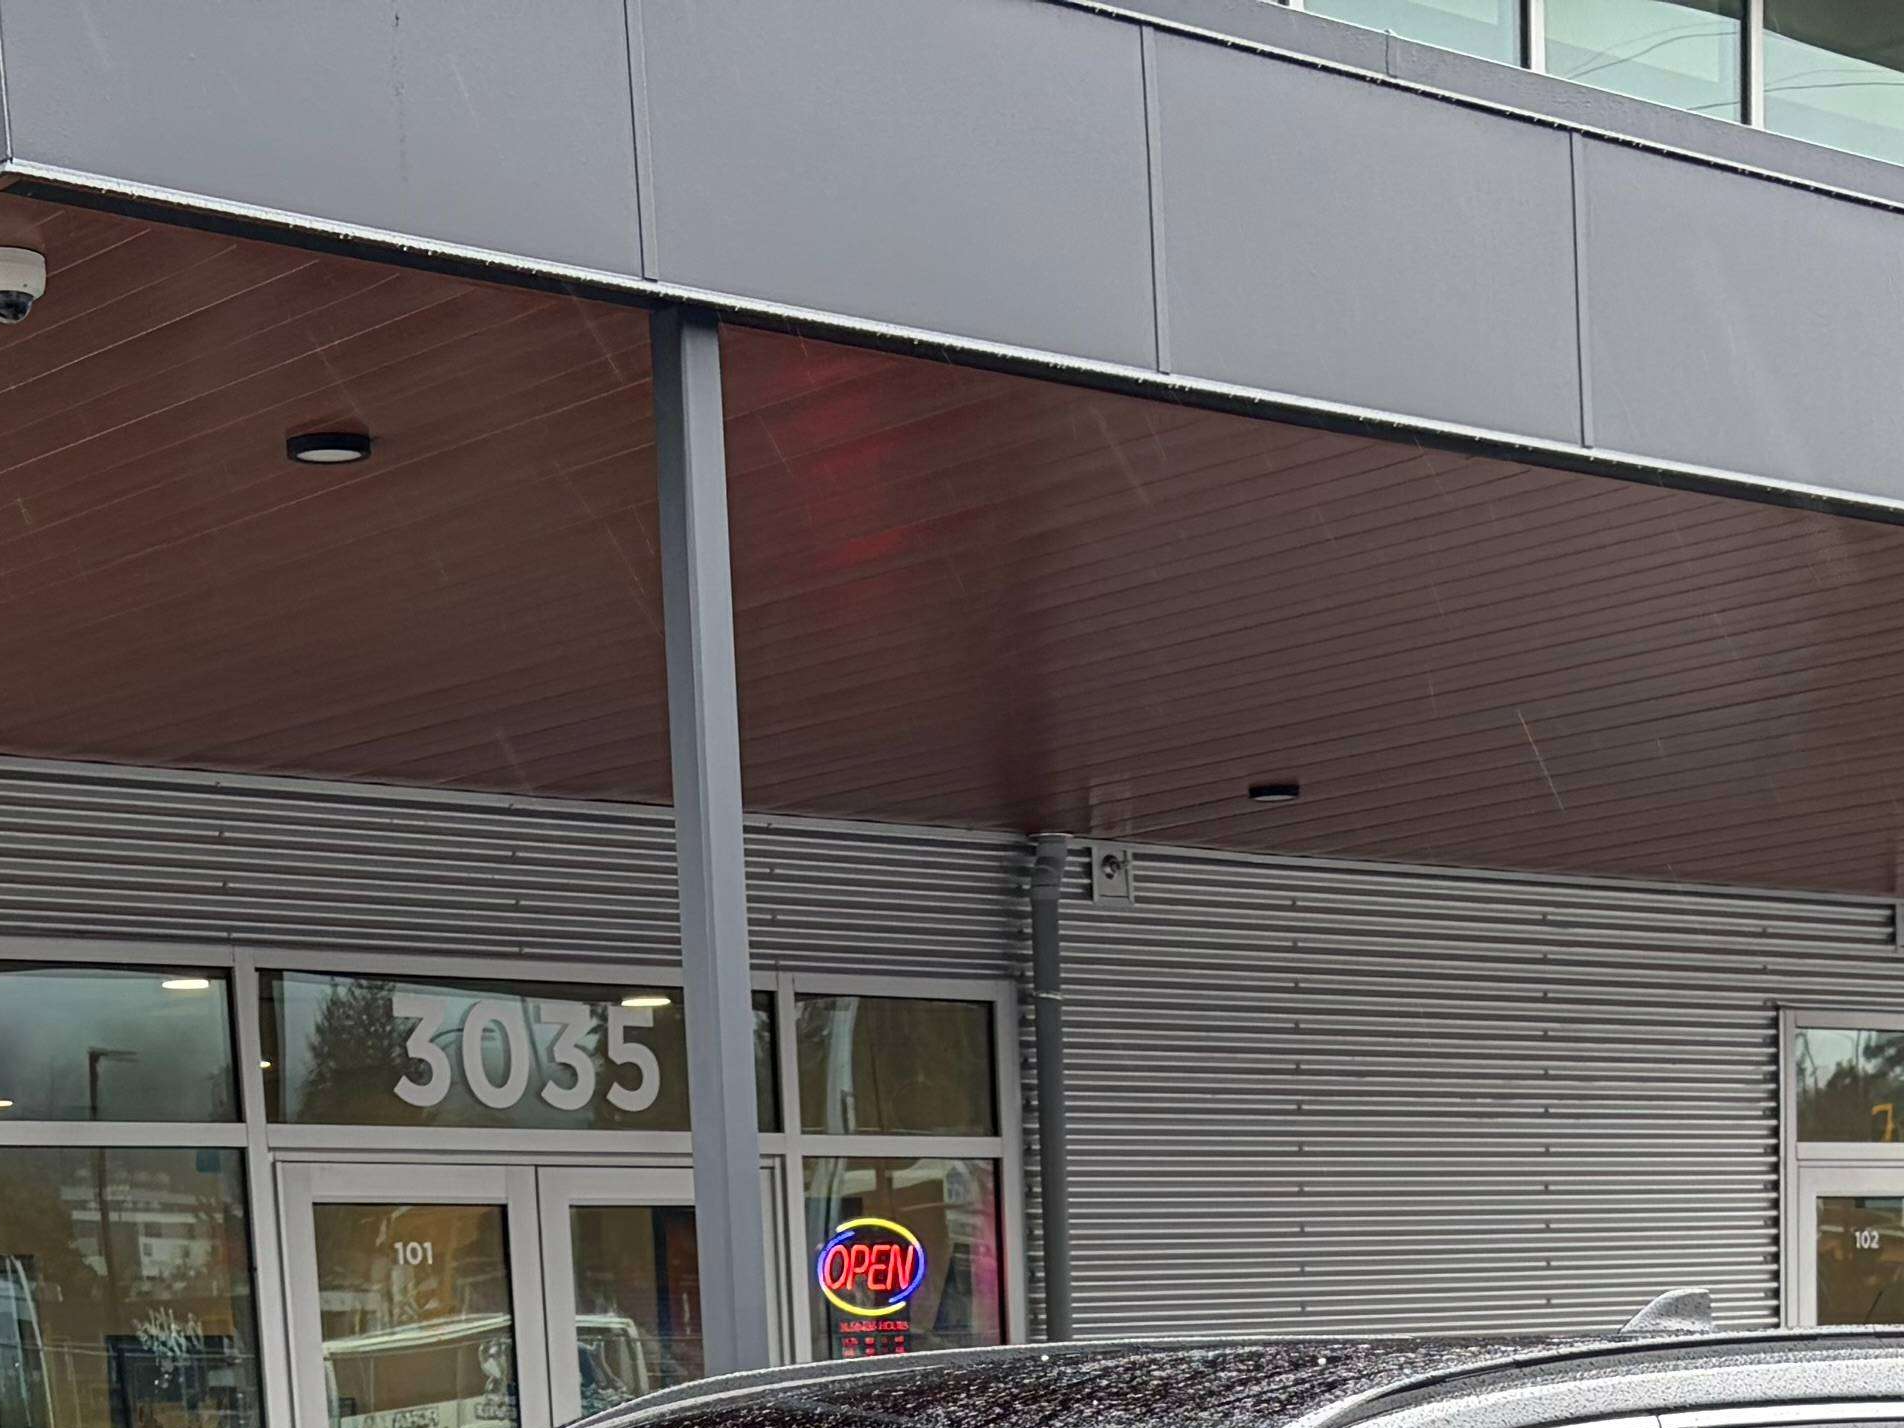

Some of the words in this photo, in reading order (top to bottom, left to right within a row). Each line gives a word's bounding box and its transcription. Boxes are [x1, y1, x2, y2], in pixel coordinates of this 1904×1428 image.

[392, 992, 661, 1112] 3035
[394, 1241, 433, 1265] 101
[1855, 1230, 1879, 1249] 102
[823, 1244, 914, 1290] OPEN
